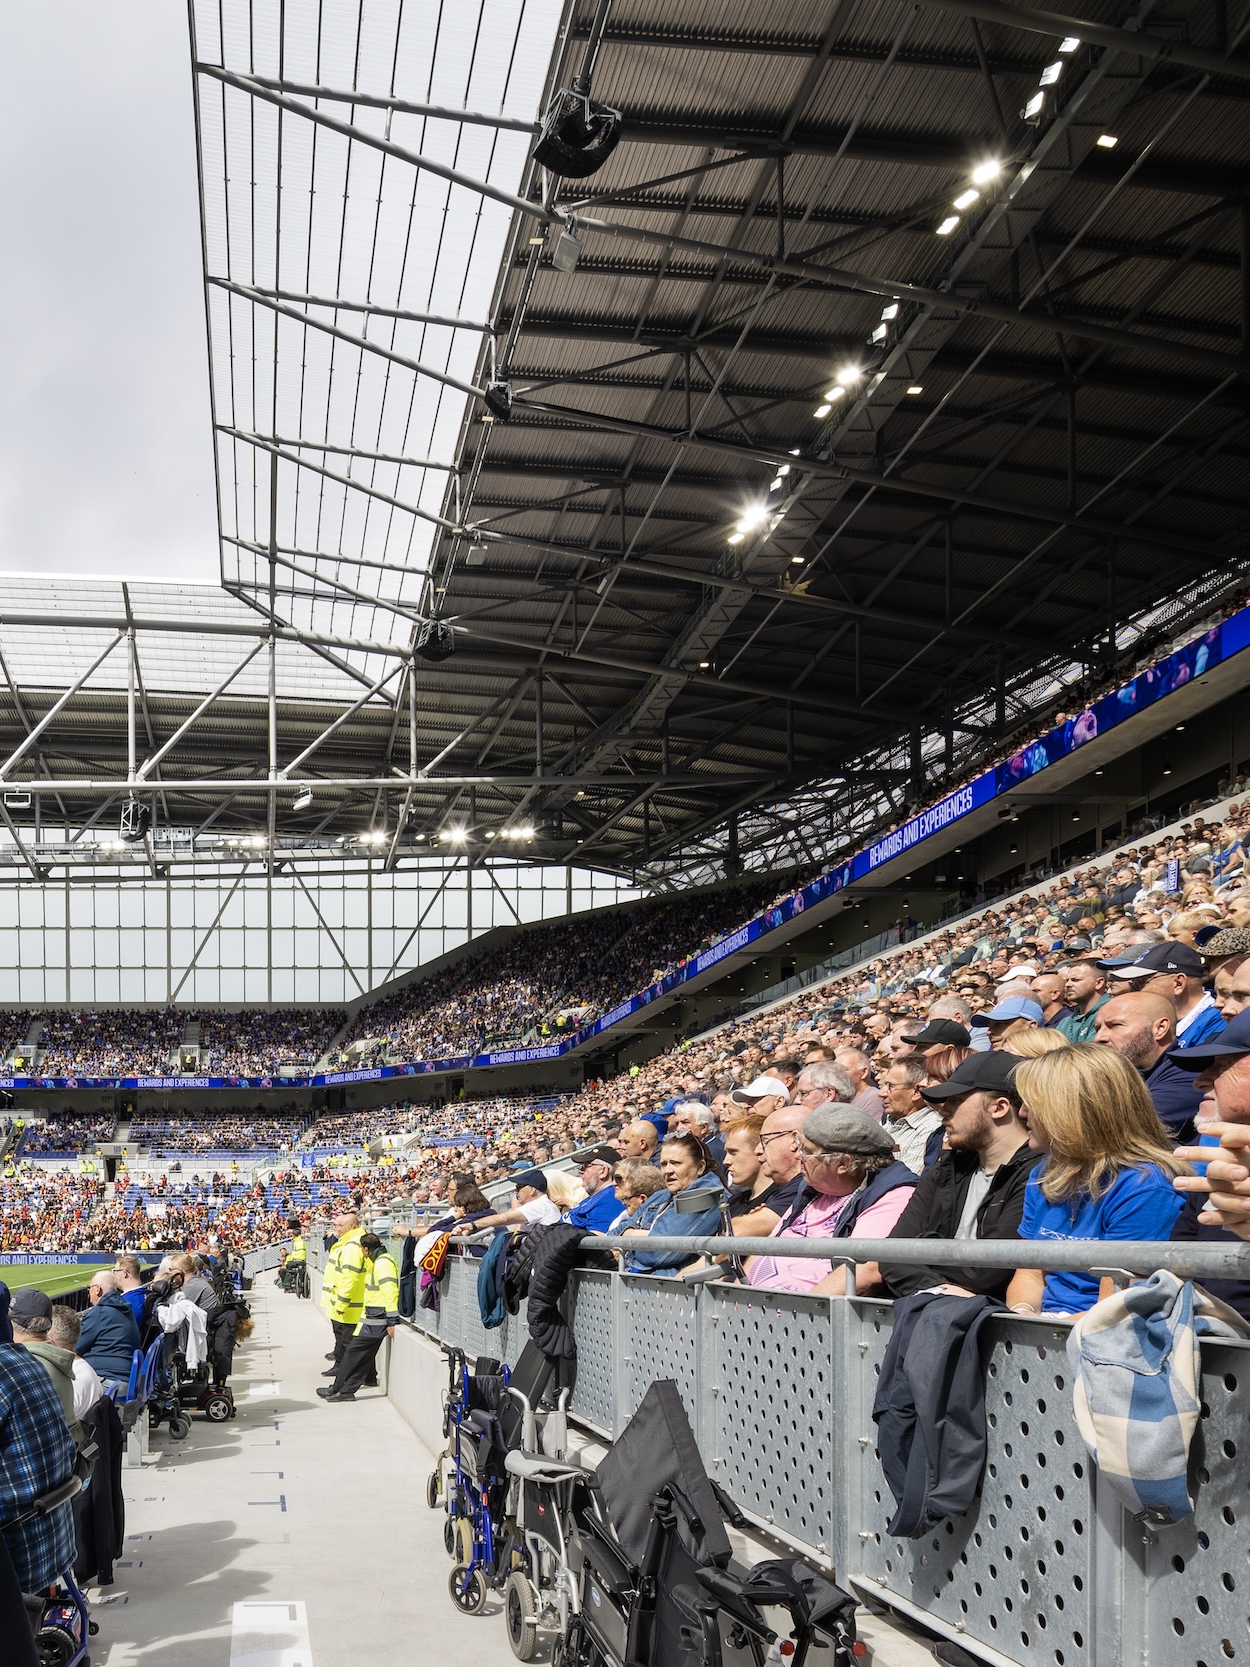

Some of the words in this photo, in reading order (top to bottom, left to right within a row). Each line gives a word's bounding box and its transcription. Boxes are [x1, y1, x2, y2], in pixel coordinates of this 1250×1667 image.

[870, 837, 902, 868] REWARDS
[903, 826, 919, 850] AND
[920, 789, 973, 840] EXPERIENCES
[490, 1052, 514, 1064] REWARDS
[515, 1052, 526, 1061] AND
[138, 1078, 162, 1087] REWARDS
[163, 1078, 174, 1087] AND
[175, 1078, 209, 1087] EXPERIENCES
[325, 1074, 344, 1084] REWARDS
[345, 1072, 353, 1082] AND
[354, 1069, 381, 1081] EXPERIENCES
[12, 1255, 28, 1264] AND
[29, 1255, 78, 1264] EXPERIENCES
